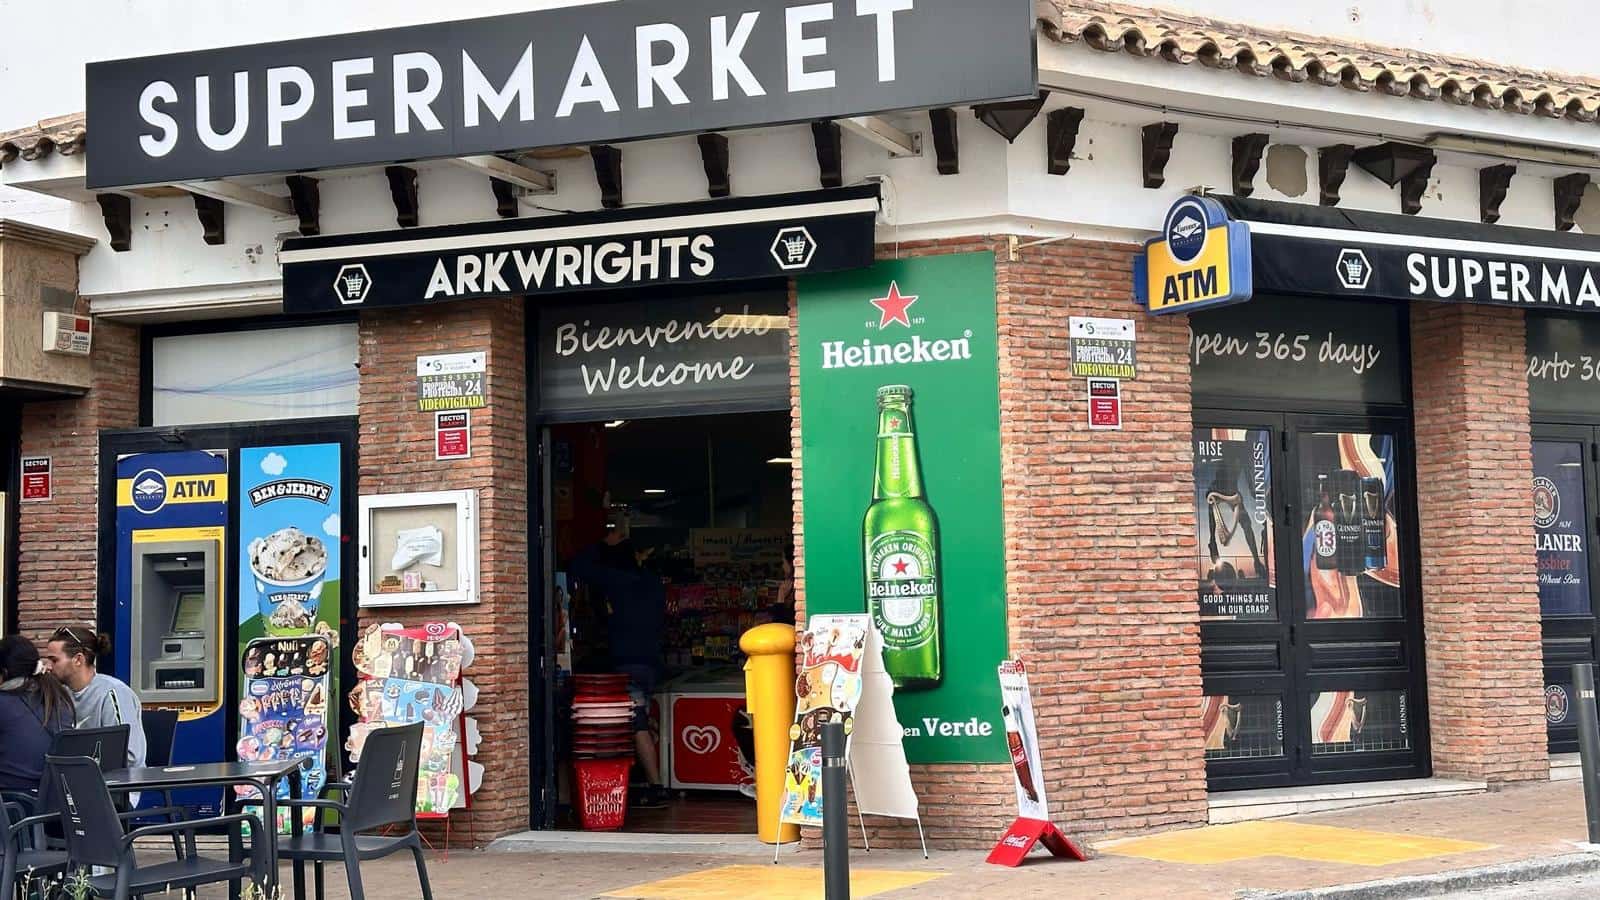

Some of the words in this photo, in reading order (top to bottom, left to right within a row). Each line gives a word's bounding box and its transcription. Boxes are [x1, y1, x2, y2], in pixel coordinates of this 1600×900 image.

[138, 0, 913, 158] SUPERMARKET
[424, 234, 715, 299] ARKWRIGHTS
[1162, 265, 1218, 305] ATM
[1406, 252, 1600, 308] SUPERMA
[555, 304, 772, 357] Bienvenido
[821, 334, 972, 369] Heineken
[1117, 347, 1132, 365] 24
[1187, 325, 1249, 365] pen
[1255, 332, 1310, 361] 365
[1318, 332, 1381, 375] days
[580, 355, 755, 396] Welcome
[1072, 363, 1136, 378] VIDEOVIGILADA
[1527, 351, 1575, 381] erto
[465, 379, 482, 396] 24
[419, 395, 485, 411] VIDEOVIGILADA
[440, 414, 465, 422] SECTOR
[1199, 441, 1223, 456] RISE
[172, 480, 215, 499] ATM
[252, 482, 329, 503] BEN&JERRY'S
[1253, 442, 1266, 524] GUINNESS
[1535, 533, 1582, 552] LANER
[869, 581, 934, 596] Heineken
[1203, 594, 1223, 604] GOOD
[1226, 594, 1253, 603] THINGS
[1255, 594, 1269, 603] ARE
[1218, 605, 1226, 614] IN
[1228, 605, 1243, 614] OUR
[1245, 605, 1269, 614] GRASP
[891, 629, 913, 638] MALT
[922, 717, 992, 737] Verde
